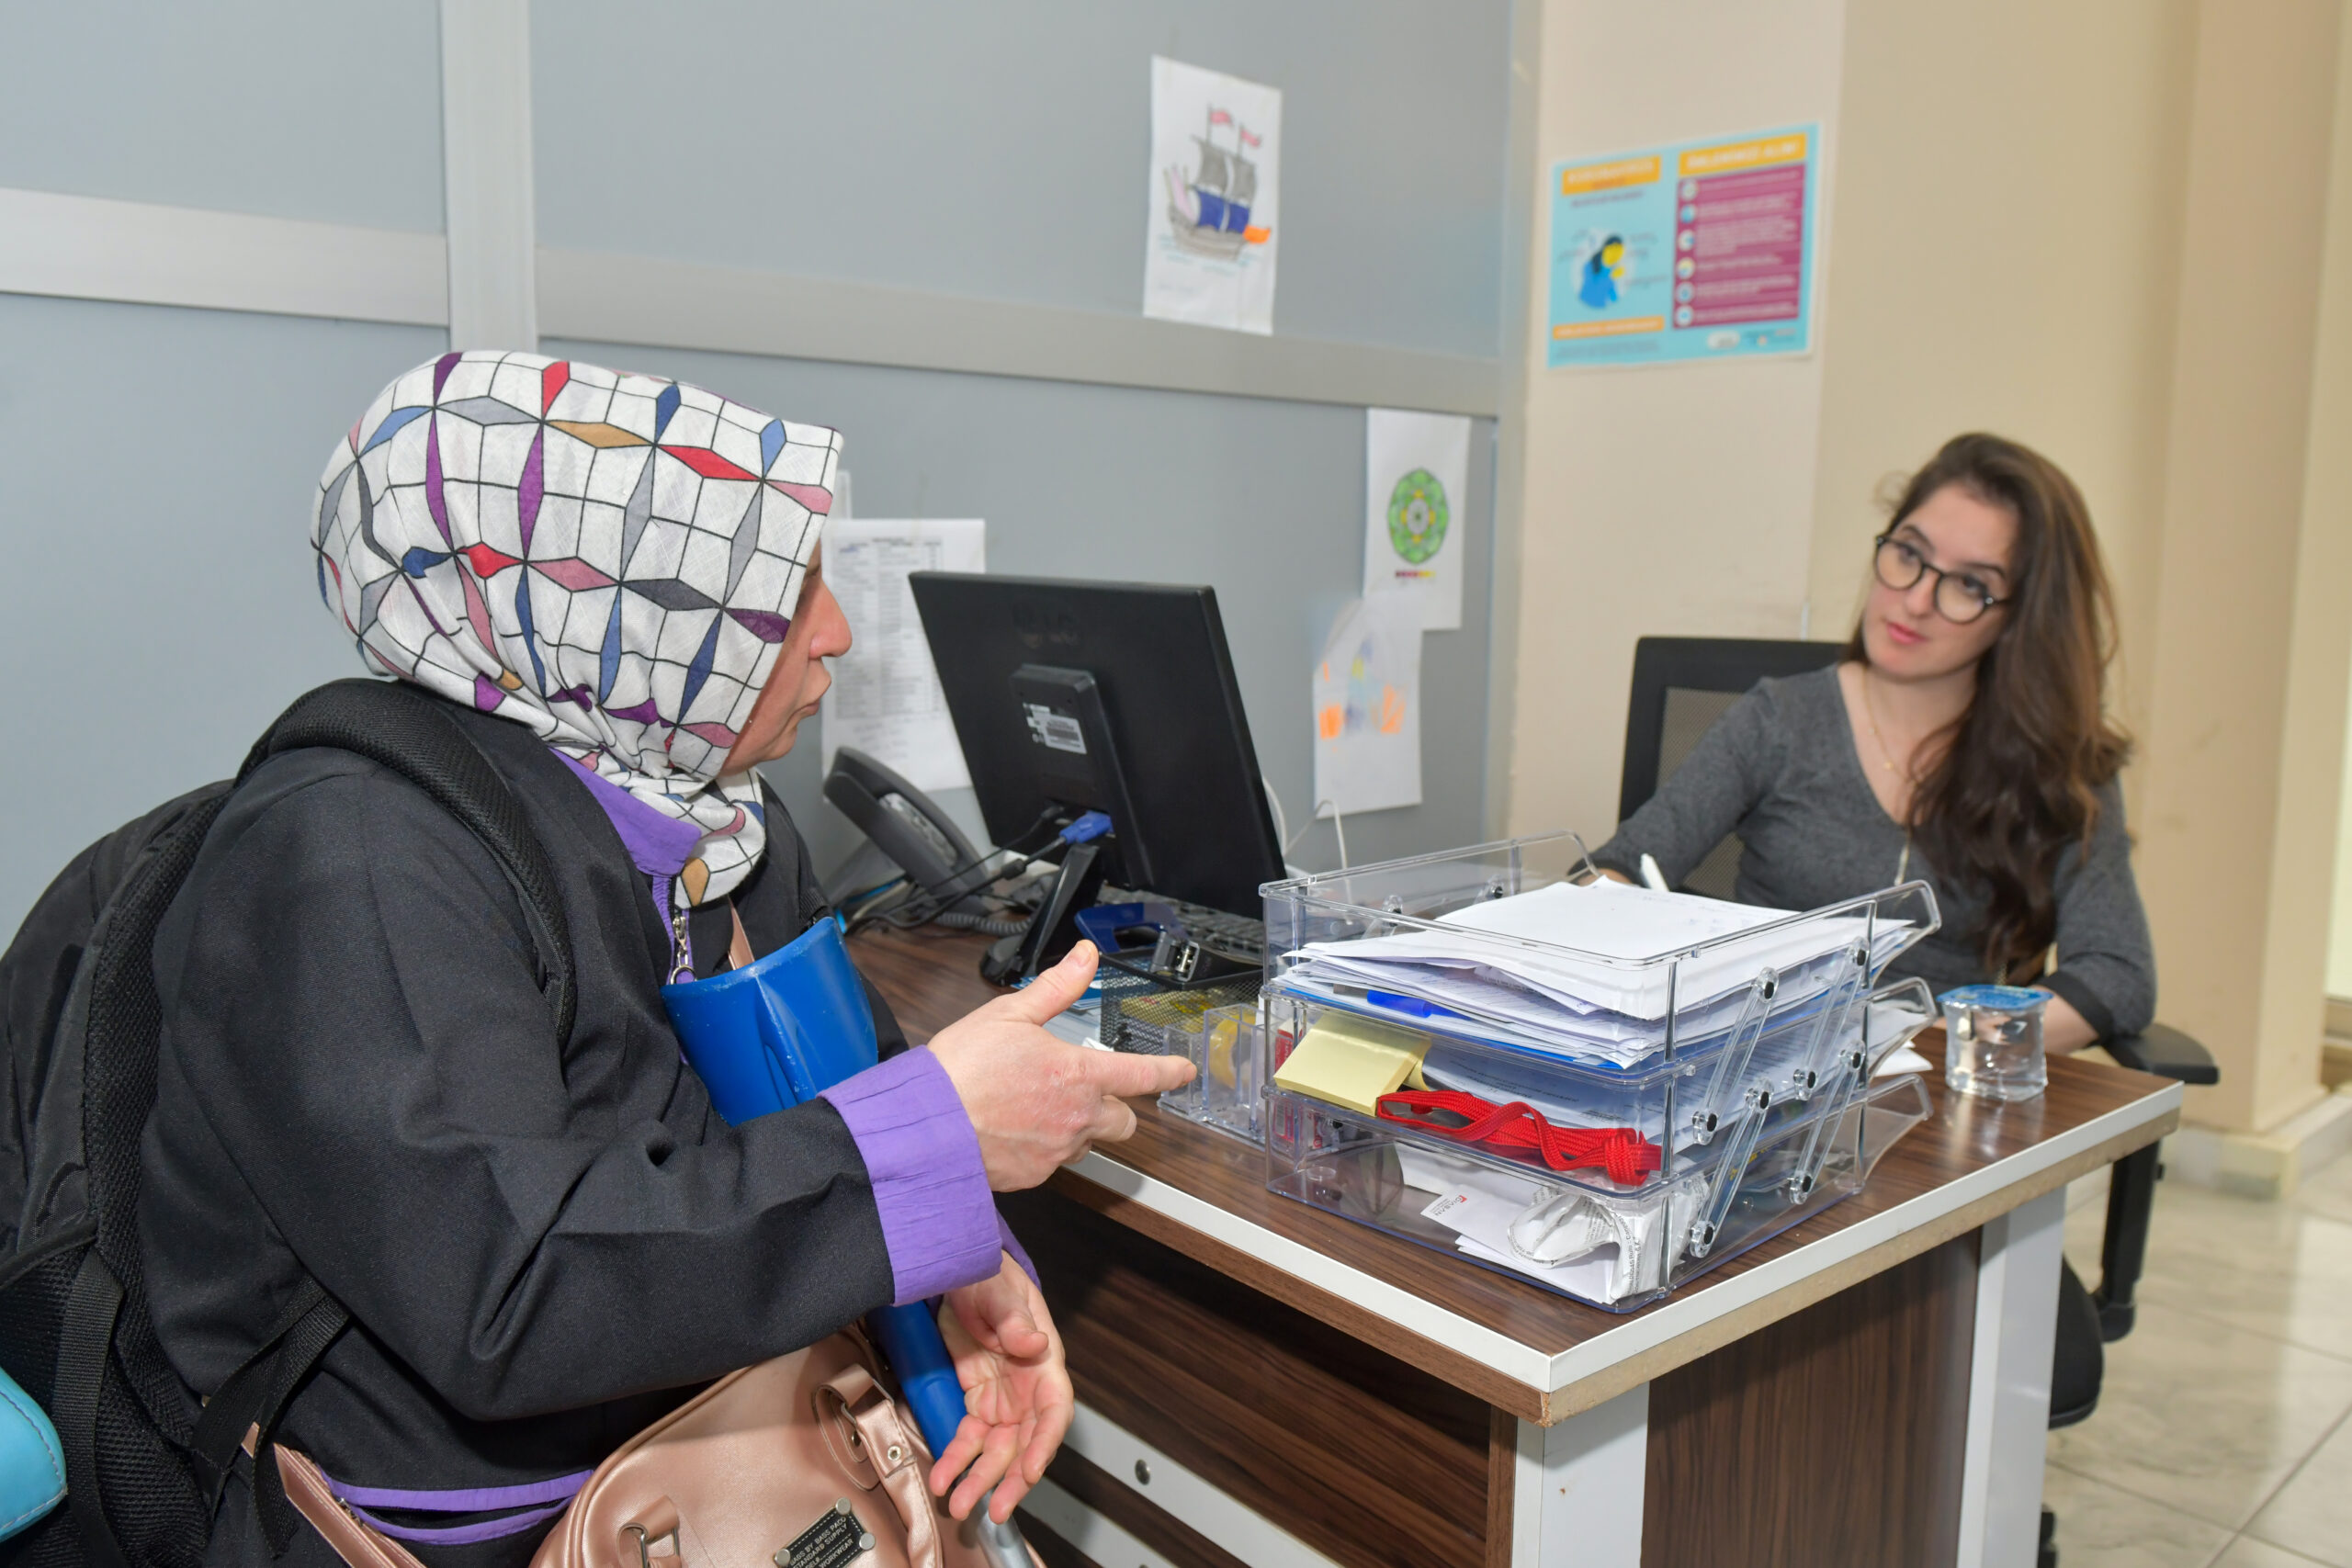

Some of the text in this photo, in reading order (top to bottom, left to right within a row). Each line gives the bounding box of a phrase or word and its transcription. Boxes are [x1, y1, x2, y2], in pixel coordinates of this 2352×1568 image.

[792, 1523, 847, 1568] STANDARD SUPPLY
[805, 1542, 814, 1552] BY
[814, 1529, 831, 1544] BAGS
[818, 1538, 854, 1568] WORKWEAR
